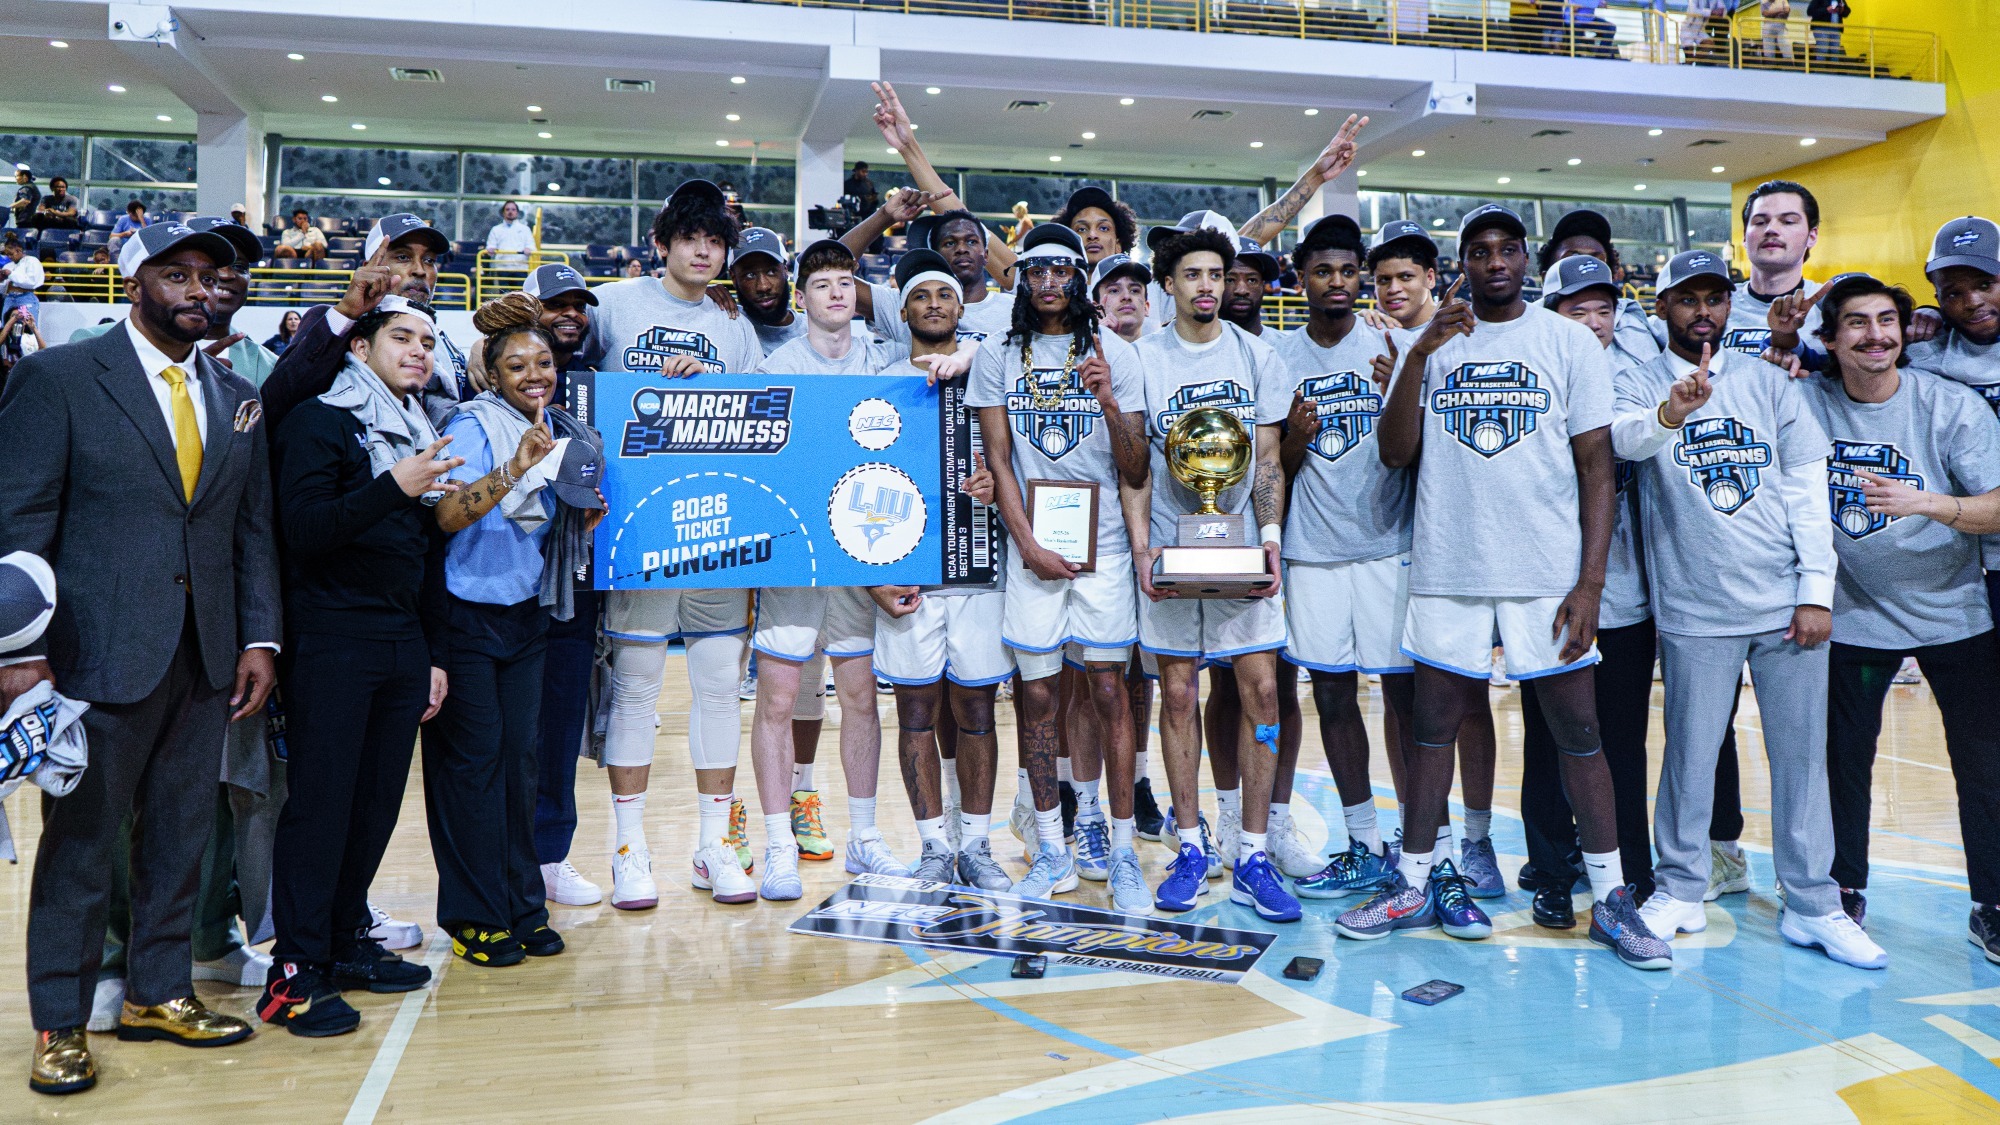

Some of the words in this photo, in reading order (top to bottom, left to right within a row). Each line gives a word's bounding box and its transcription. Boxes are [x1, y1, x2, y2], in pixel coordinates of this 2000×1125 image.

[662, 331, 698, 343] NEC
[1038, 370, 1064, 383] NE
[1471, 362, 1513, 378] NEC
[1191, 381, 1226, 398] NEC
[1313, 373, 1347, 392] NEC
[956, 387, 965, 401] 26
[1435, 391, 1547, 410] CHAMPIONS
[639, 402, 661, 410] NCAA
[661, 393, 748, 418] MARCH
[945, 386, 955, 435] QUALIFIER
[956, 402, 966, 425] SEAT
[1007, 396, 1102, 413] CHPIONS
[1306, 398, 1379, 416] MPIONS
[671, 419, 787, 443] MADNESS
[855, 414, 896, 430] NEC
[1694, 419, 1726, 438] NEC
[1684, 441, 1704, 451] MEN'S
[1842, 445, 1883, 457] NEC
[945, 436, 955, 489] AUTOMATIC
[957, 458, 966, 470] 15
[672, 492, 728, 522] 2026
[848, 481, 914, 523] LIU
[1045, 493, 1081, 508] NEC
[674, 516, 732, 542] TICKET
[946, 490, 956, 553] TOURNAMENT
[958, 526, 968, 534] 3
[642, 532, 772, 582] PUNCHED
[958, 535, 968, 577] SECTION
[947, 554, 957, 578] NCAA
[854, 875, 938, 890] 2025-26
[814, 899, 957, 922] NEC
[908, 894, 1261, 962] Champions
[1056, 954, 1115, 968] MEN'S
[1115, 960, 1225, 980] BASKETBALL
